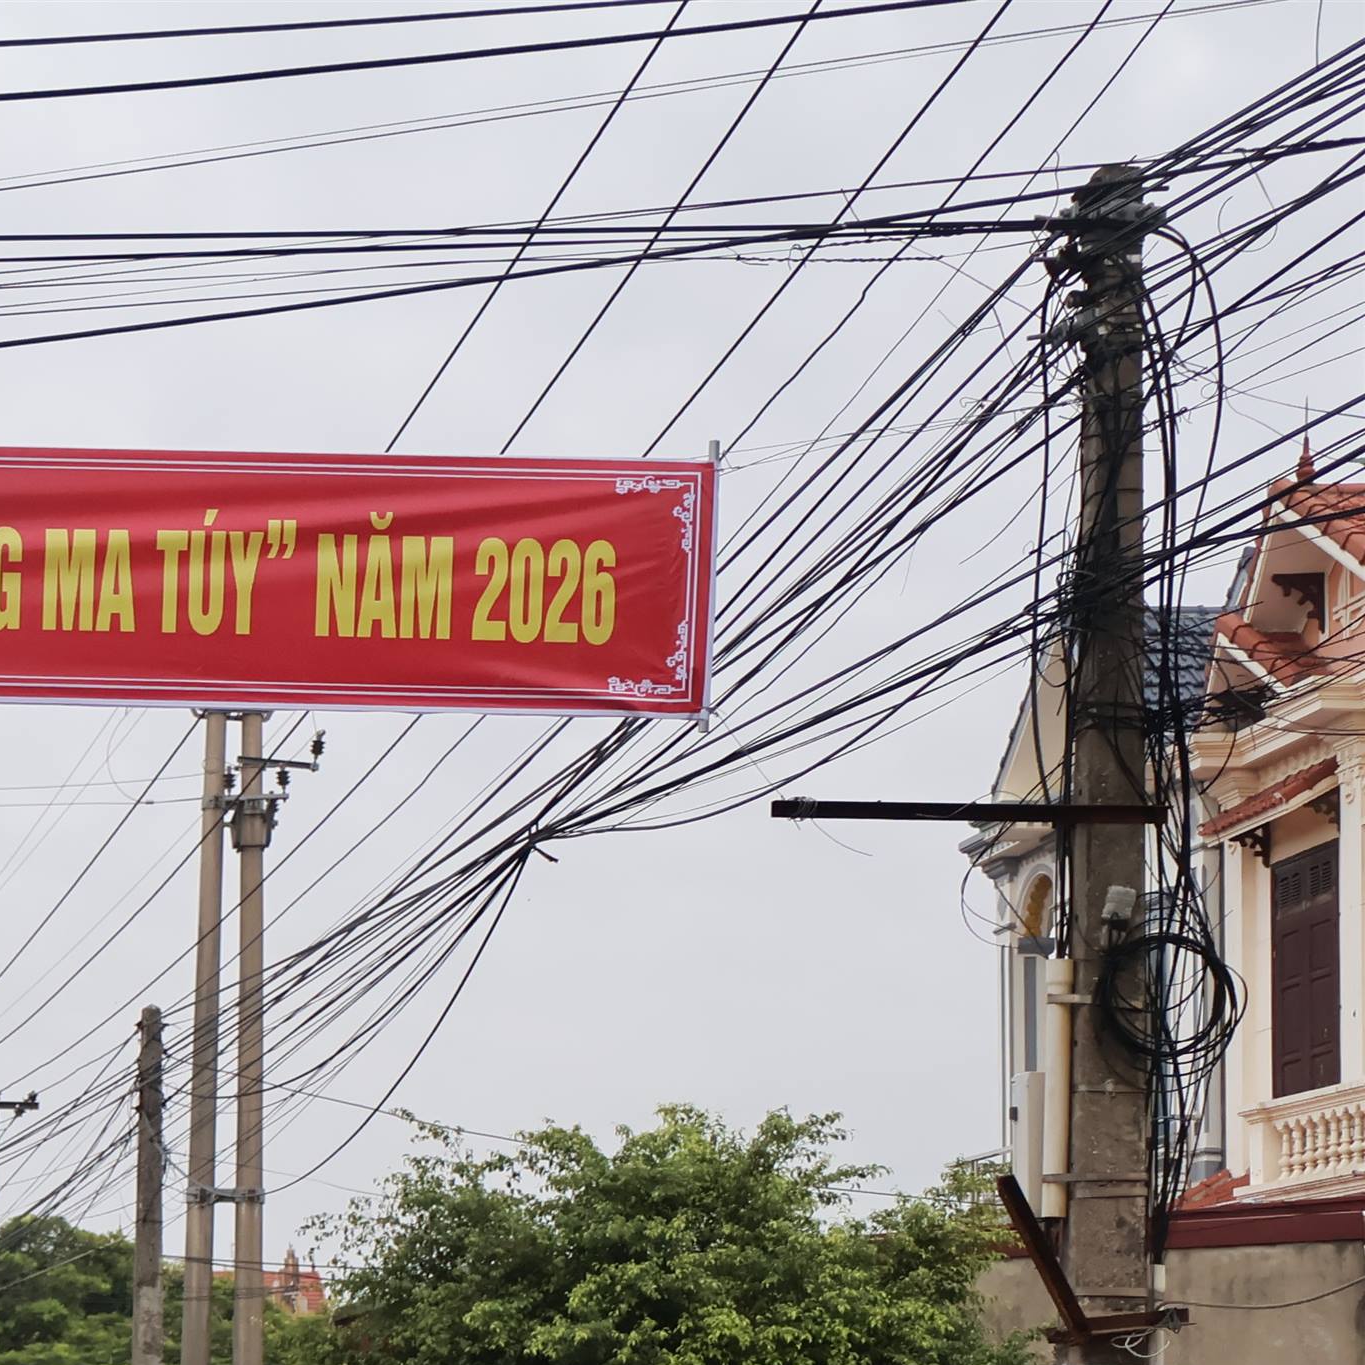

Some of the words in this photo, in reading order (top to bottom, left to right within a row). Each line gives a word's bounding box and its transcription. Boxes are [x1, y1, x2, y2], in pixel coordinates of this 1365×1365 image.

[43, 529, 135, 631] MA
[316, 511, 455, 640] NĂM
[472, 538, 617, 645] 2026
